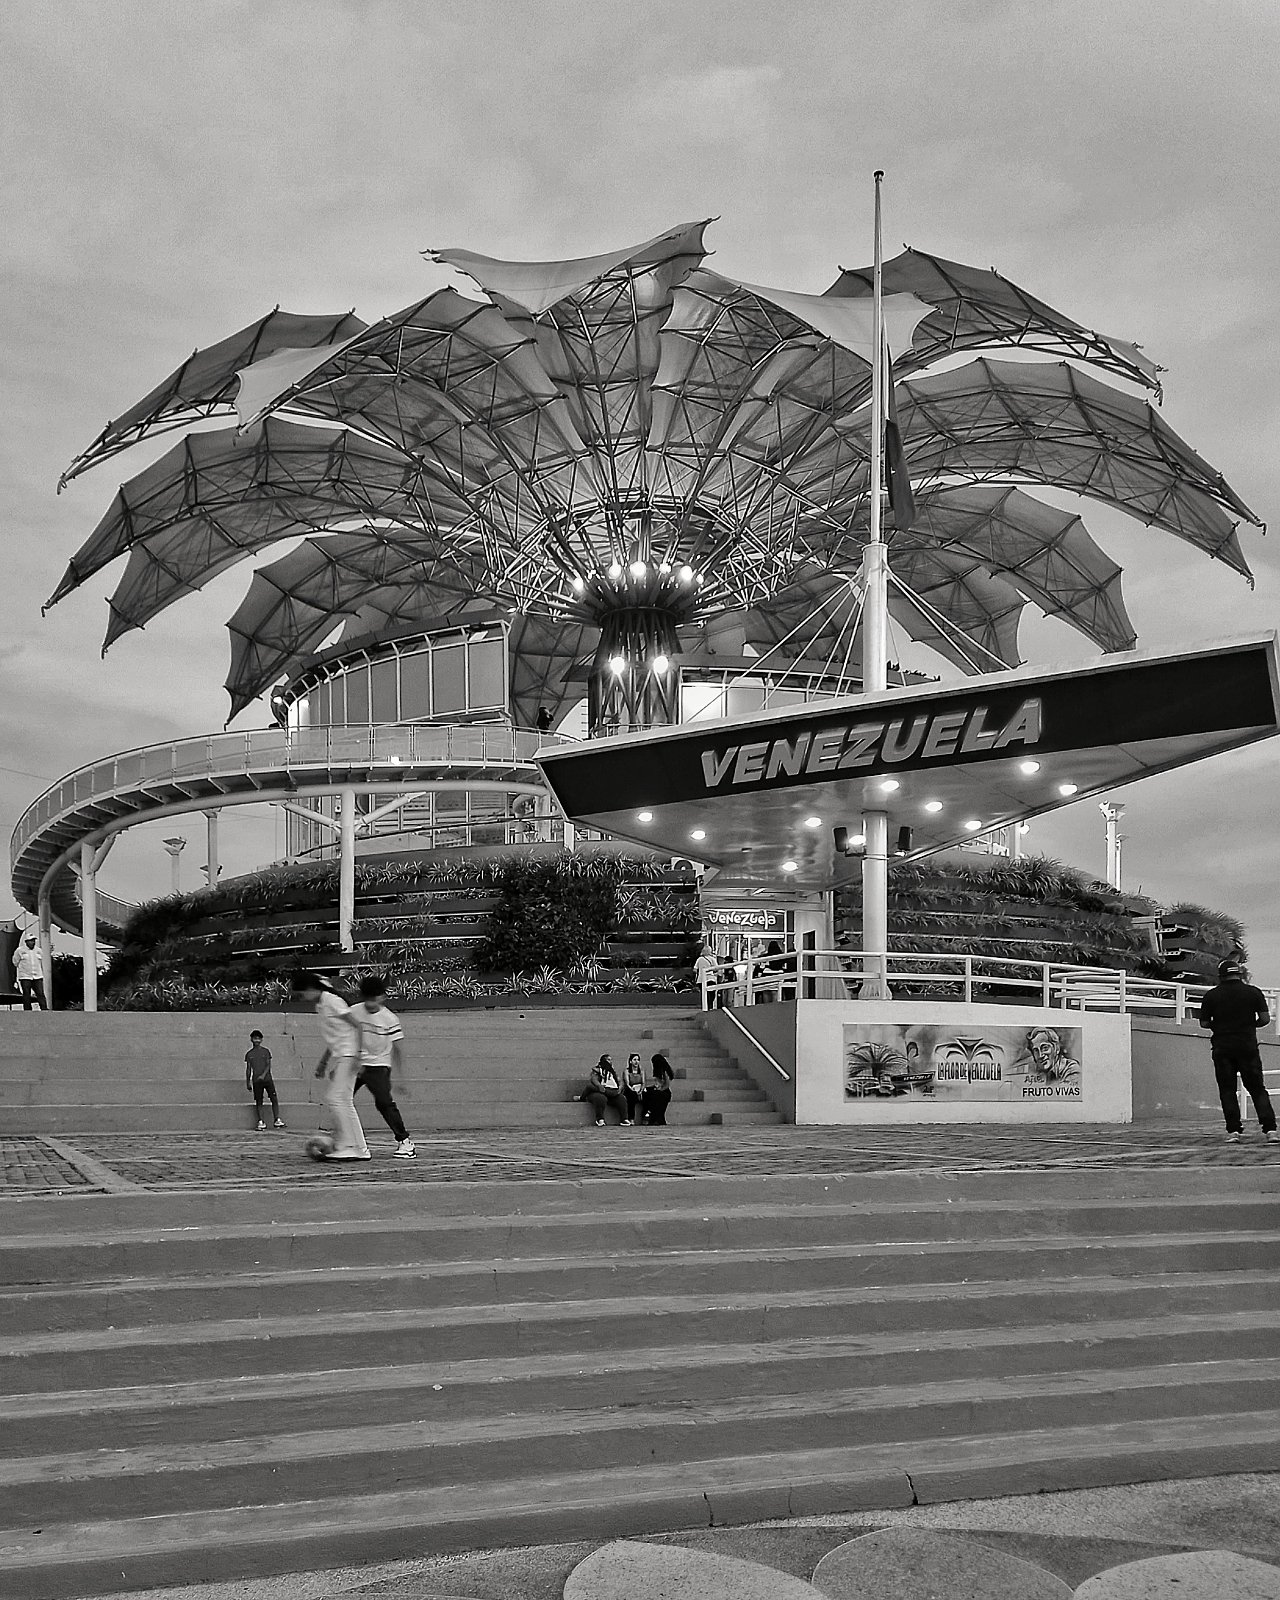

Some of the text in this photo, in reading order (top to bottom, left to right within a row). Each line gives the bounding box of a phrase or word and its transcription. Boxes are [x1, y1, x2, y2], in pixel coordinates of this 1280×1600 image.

[701, 697, 1042, 788] VENEZUELA
[1023, 1086, 1080, 1097] FRUTO VIVAS
